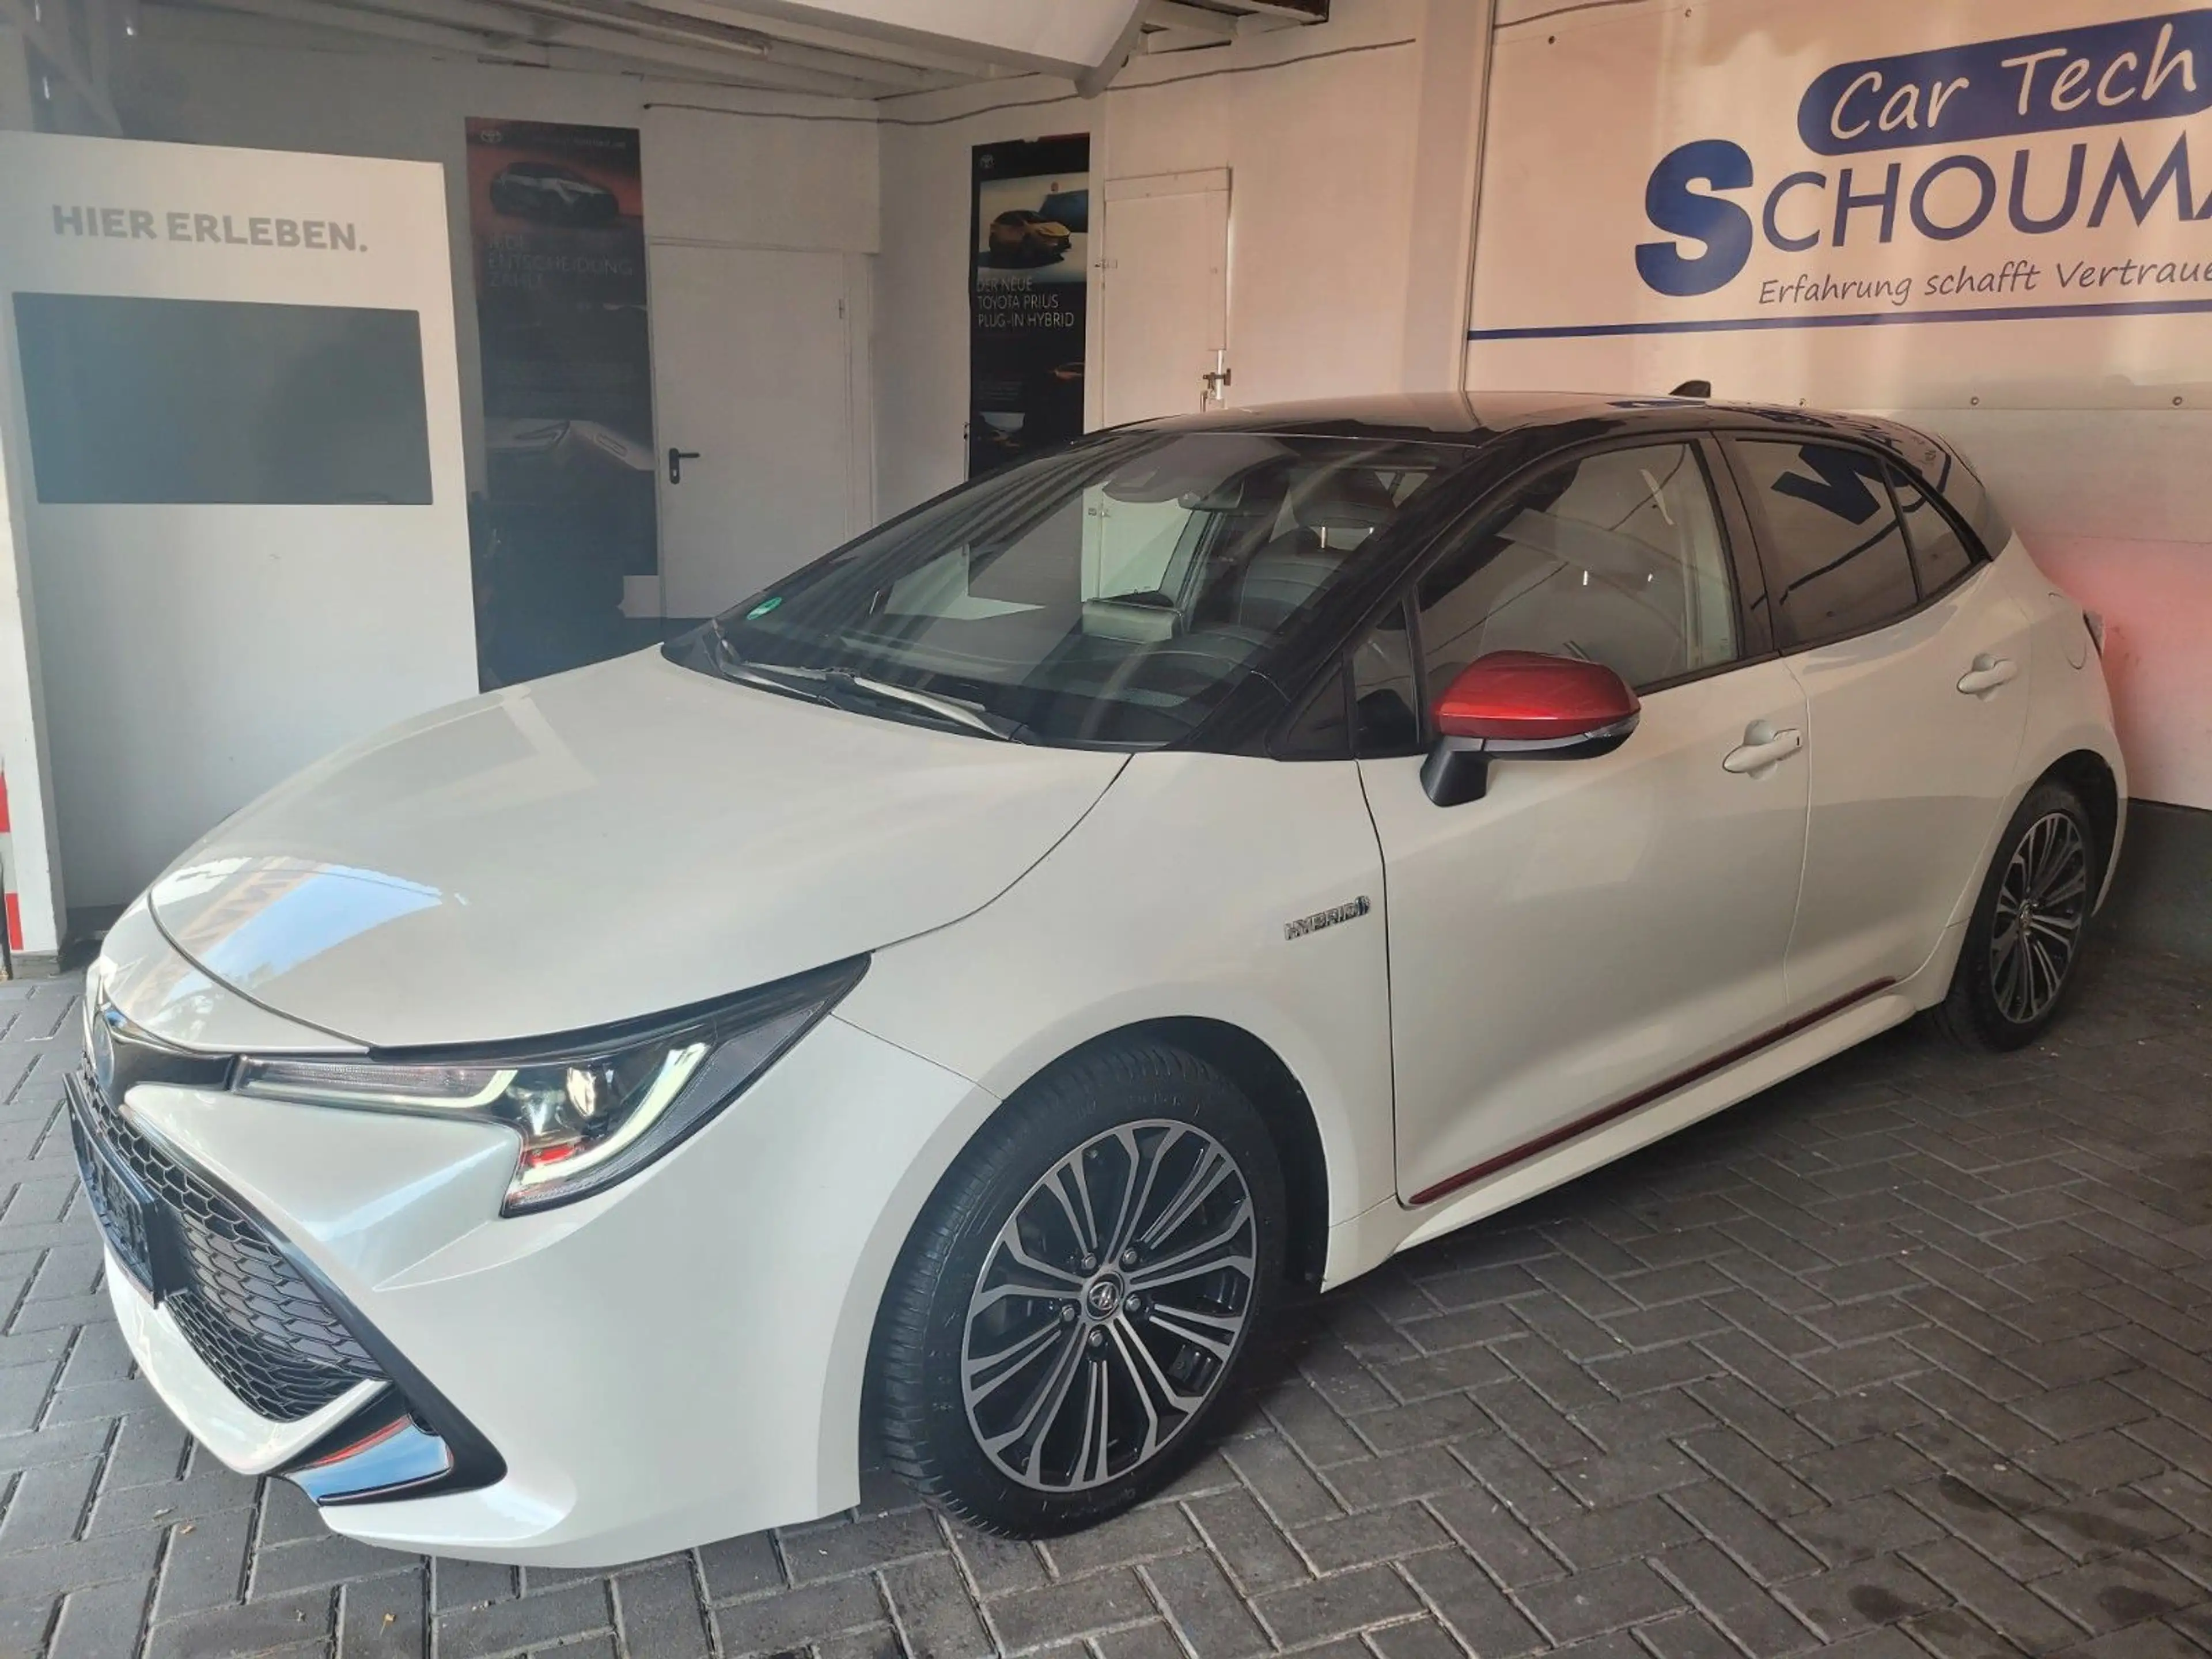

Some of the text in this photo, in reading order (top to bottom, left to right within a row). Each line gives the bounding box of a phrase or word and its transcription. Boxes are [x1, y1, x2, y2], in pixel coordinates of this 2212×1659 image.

[1831, 23, 2197, 139] Car Tech
[52, 204, 368, 252] HIER ERLEBEN.
[1001, 276, 1033, 291] NEUE
[1759, 274, 1912, 306] Erfahrung
[1925, 260, 2041, 296] schafft
[978, 294, 1059, 310] TOYOTA PRIUS
[978, 312, 1075, 328] PLUG-IN HYBRID
